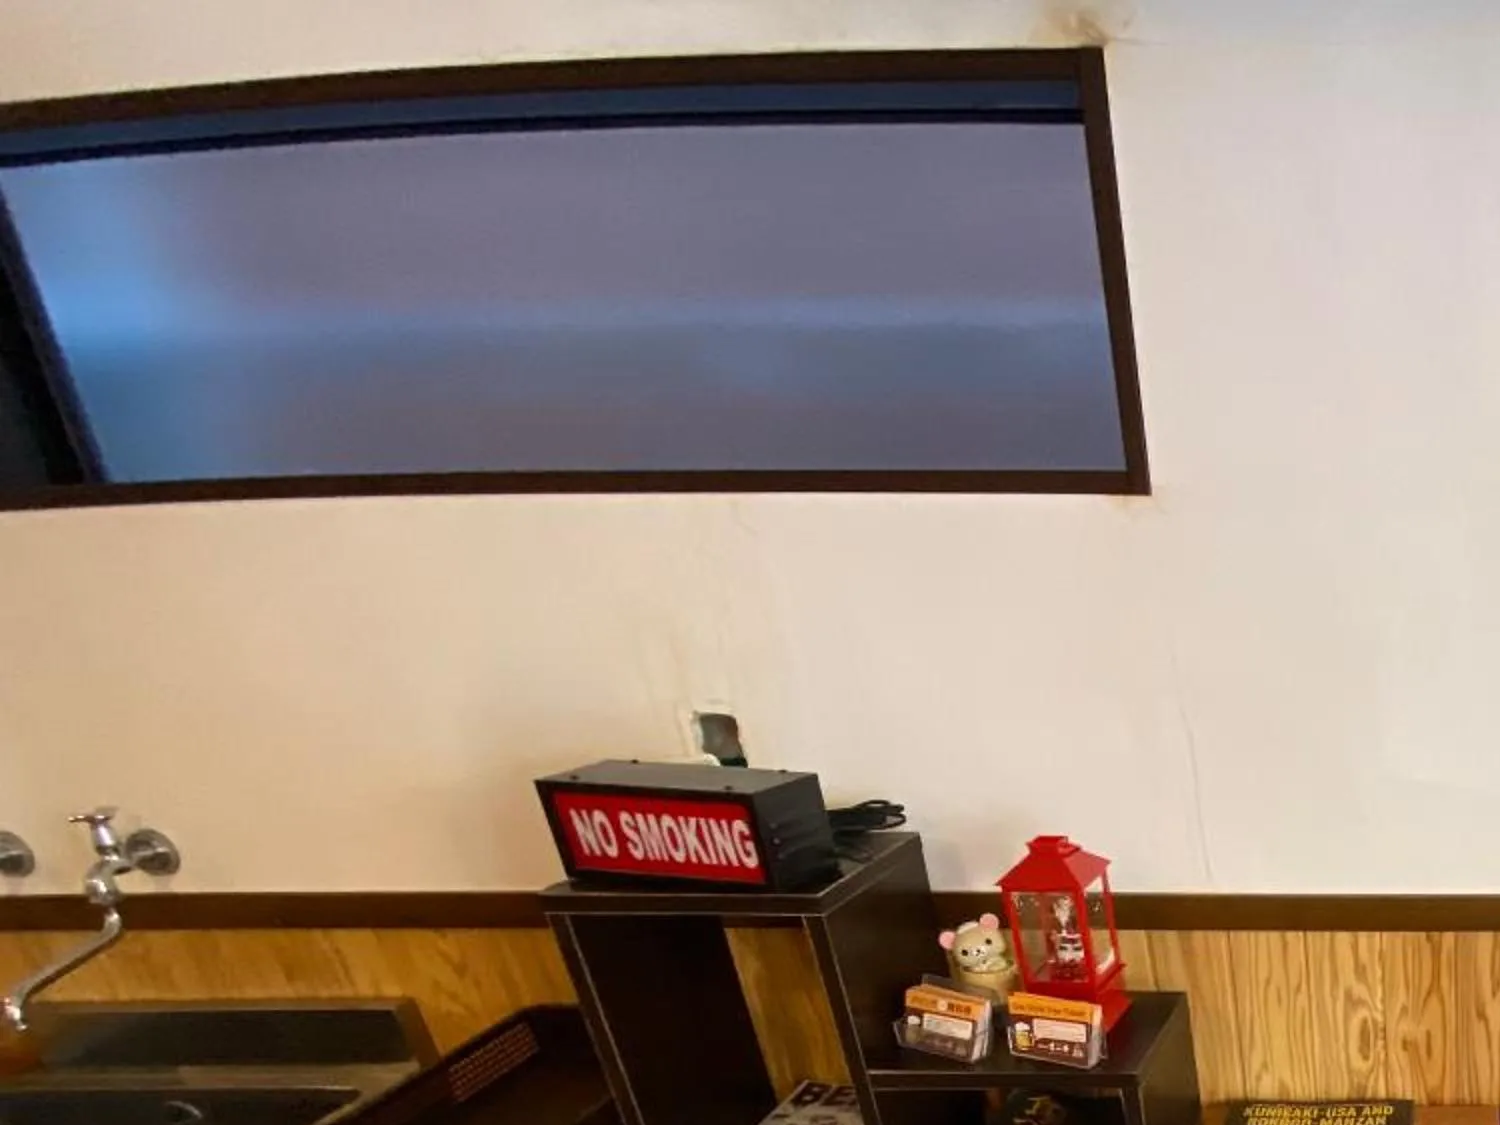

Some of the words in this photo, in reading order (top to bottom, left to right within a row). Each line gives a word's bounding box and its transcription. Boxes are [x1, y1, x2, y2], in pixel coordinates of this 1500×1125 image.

[569, 807, 619, 859] NO
[618, 810, 760, 870] SMOKING
[1361, 1104, 1394, 1116] AND
